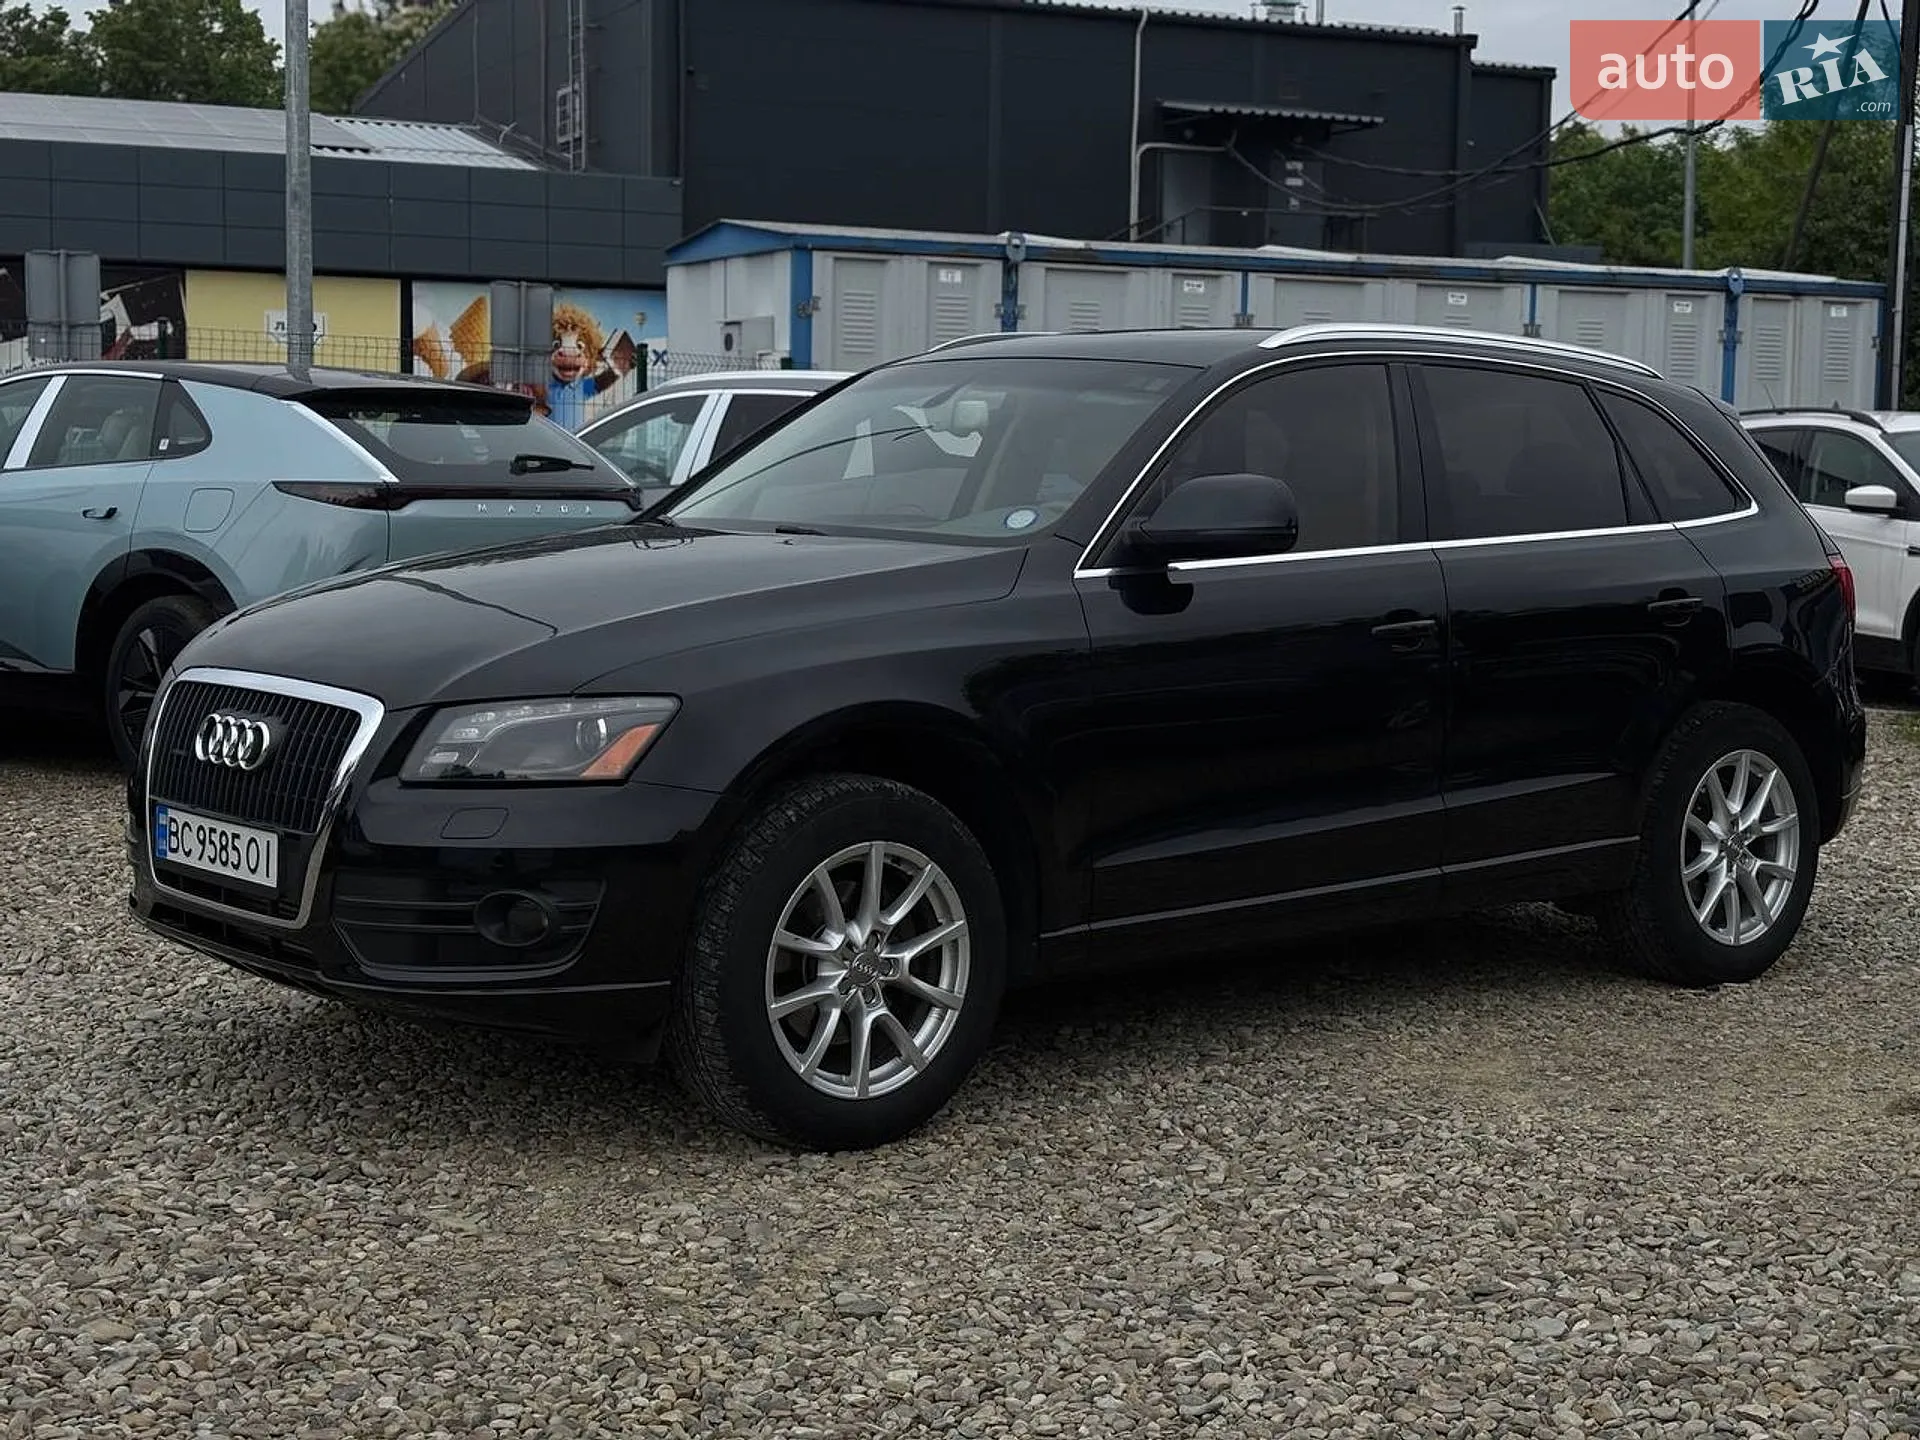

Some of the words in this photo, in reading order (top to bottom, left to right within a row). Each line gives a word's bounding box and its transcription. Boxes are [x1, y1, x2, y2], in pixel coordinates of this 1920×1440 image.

[477, 503, 594, 515] MAZDA
[168, 815, 193, 858] BC
[196, 824, 242, 871] 9585
[246, 837, 271, 879] OI
